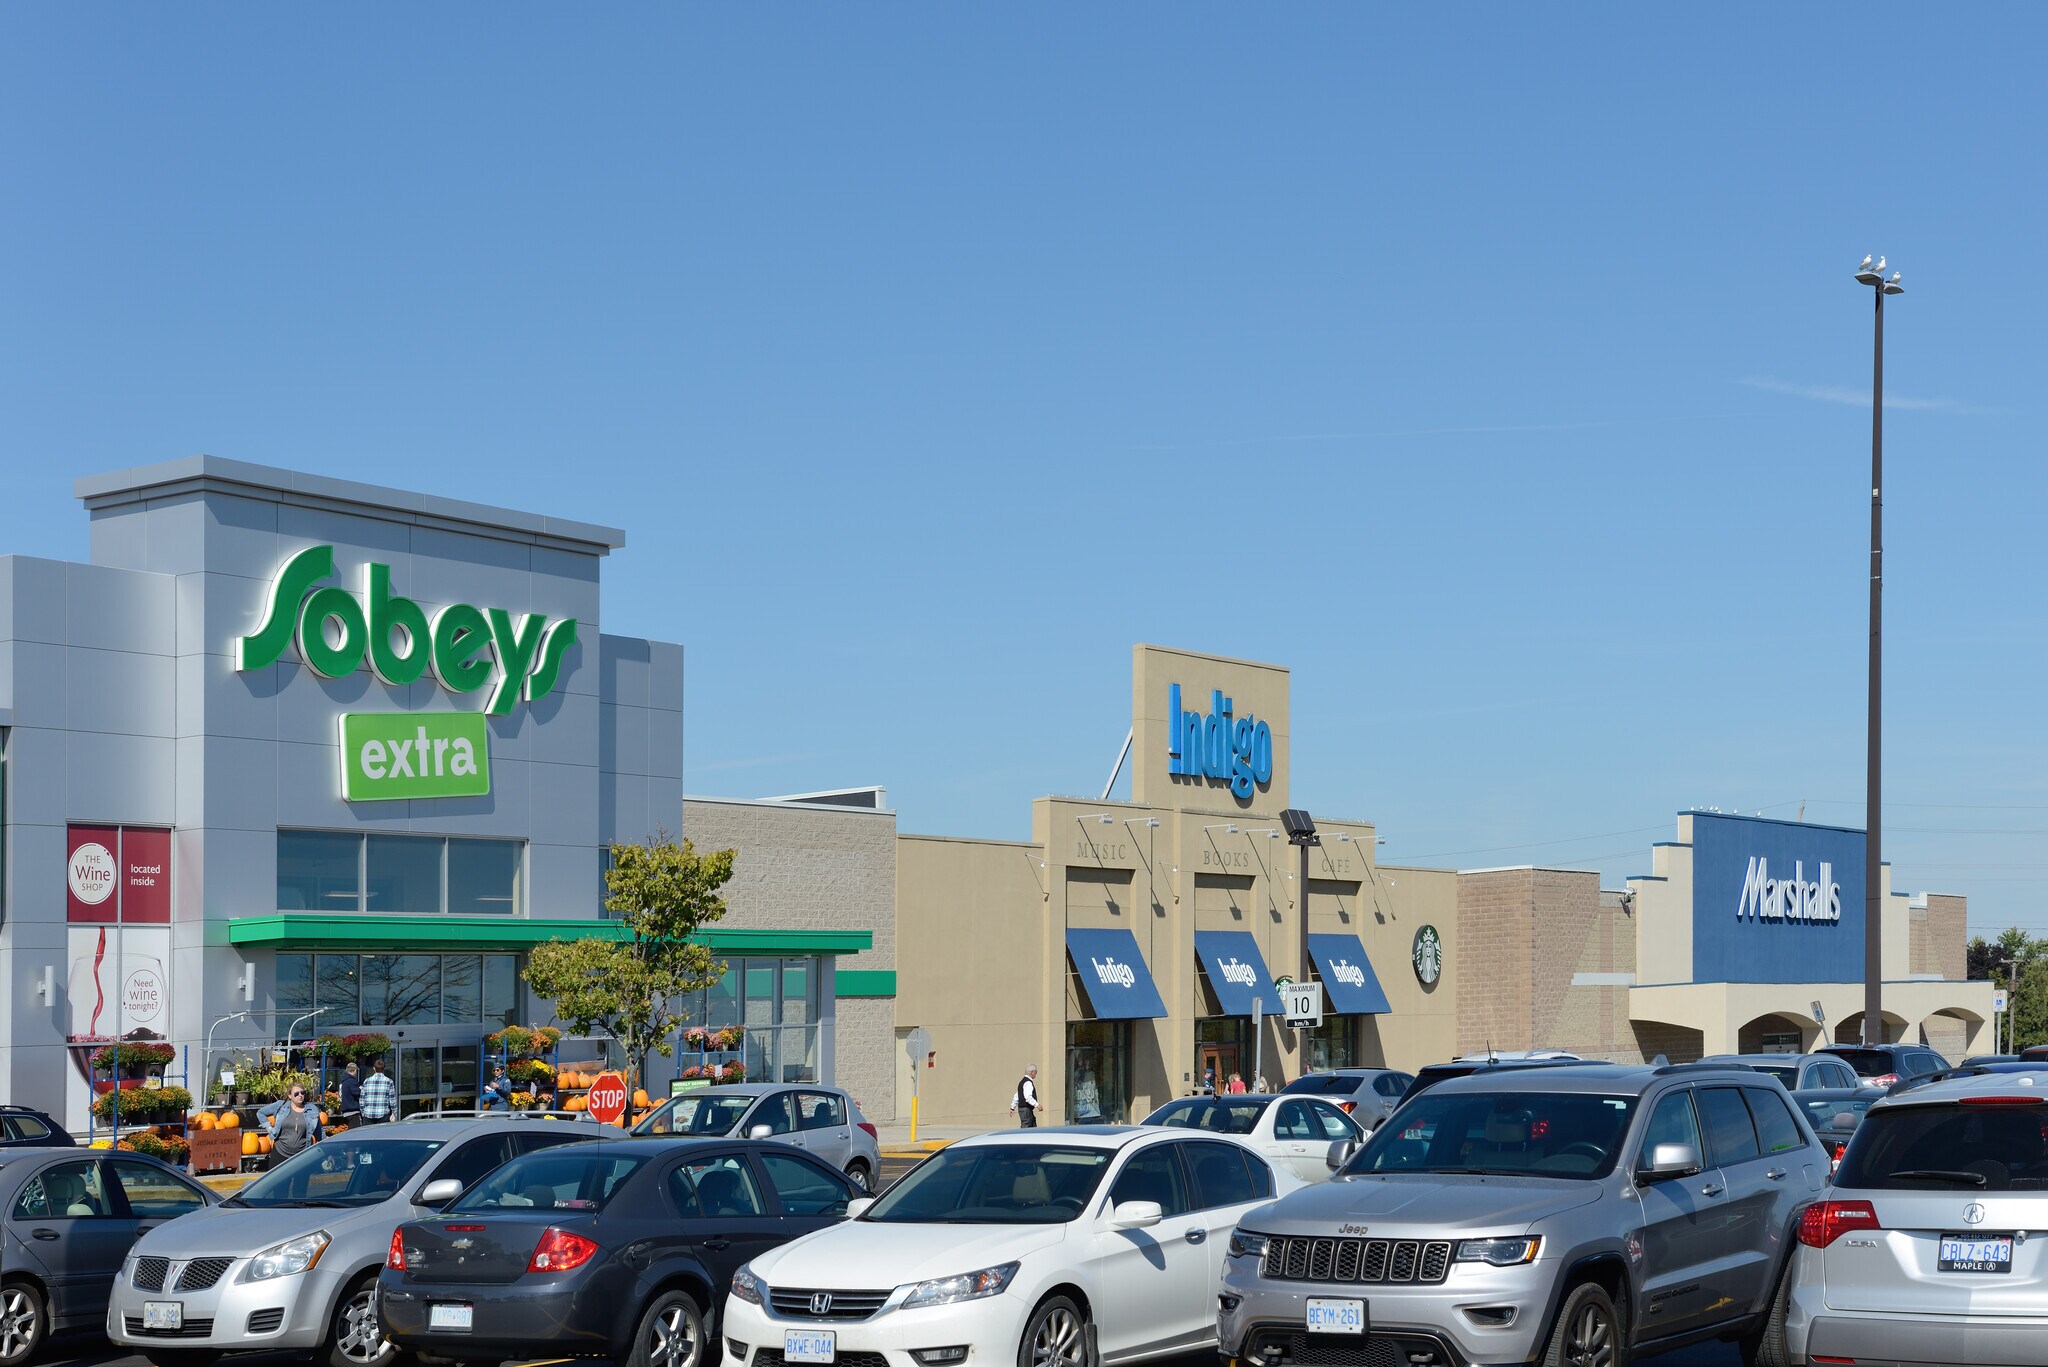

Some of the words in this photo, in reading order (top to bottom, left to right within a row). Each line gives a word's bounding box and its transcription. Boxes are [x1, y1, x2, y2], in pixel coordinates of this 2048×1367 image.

[235, 545, 577, 716] Sobeys
[1168, 683, 1273, 799] Indigo
[360, 726, 477, 779] extra
[85, 855, 101, 864] THE
[1077, 842, 1126, 860] MUSIC
[1203, 850, 1249, 867] BOOKS
[75, 865, 111, 881] Wine
[130, 864, 161, 874] located
[1321, 856, 1350, 873] CAFÉ
[82, 882, 103, 892] SHOP
[130, 876, 155, 887] inside
[1737, 856, 1841, 920] Marshalls
[1091, 957, 1135, 989] Indigo
[1217, 957, 1257, 987] Indigo
[1328, 959, 1365, 988] Indigo
[133, 979, 154, 988] Need
[1289, 985, 1316, 993] MAXIMUM
[129, 988, 158, 1001] wine
[128, 1001, 159, 1013] tonight?
[1294, 996, 1310, 1015] 10
[1294, 1020, 1310, 1028] km/h
[591, 1089, 624, 1109] STOP
[1338, 1223, 1369, 1237] Jeep
[1844, 1240, 1878, 1248] ACURA
[1941, 1243, 1975, 1261] CBLZ
[1983, 1244, 2009, 1262] 643
[1953, 1262, 1982, 1270] MAPLE
[1308, 1308, 1335, 1324] BEYM
[1341, 1308, 1360, 1325] 261
[786, 1338, 809, 1354] BXWE
[814, 1339, 832, 1355] 044
